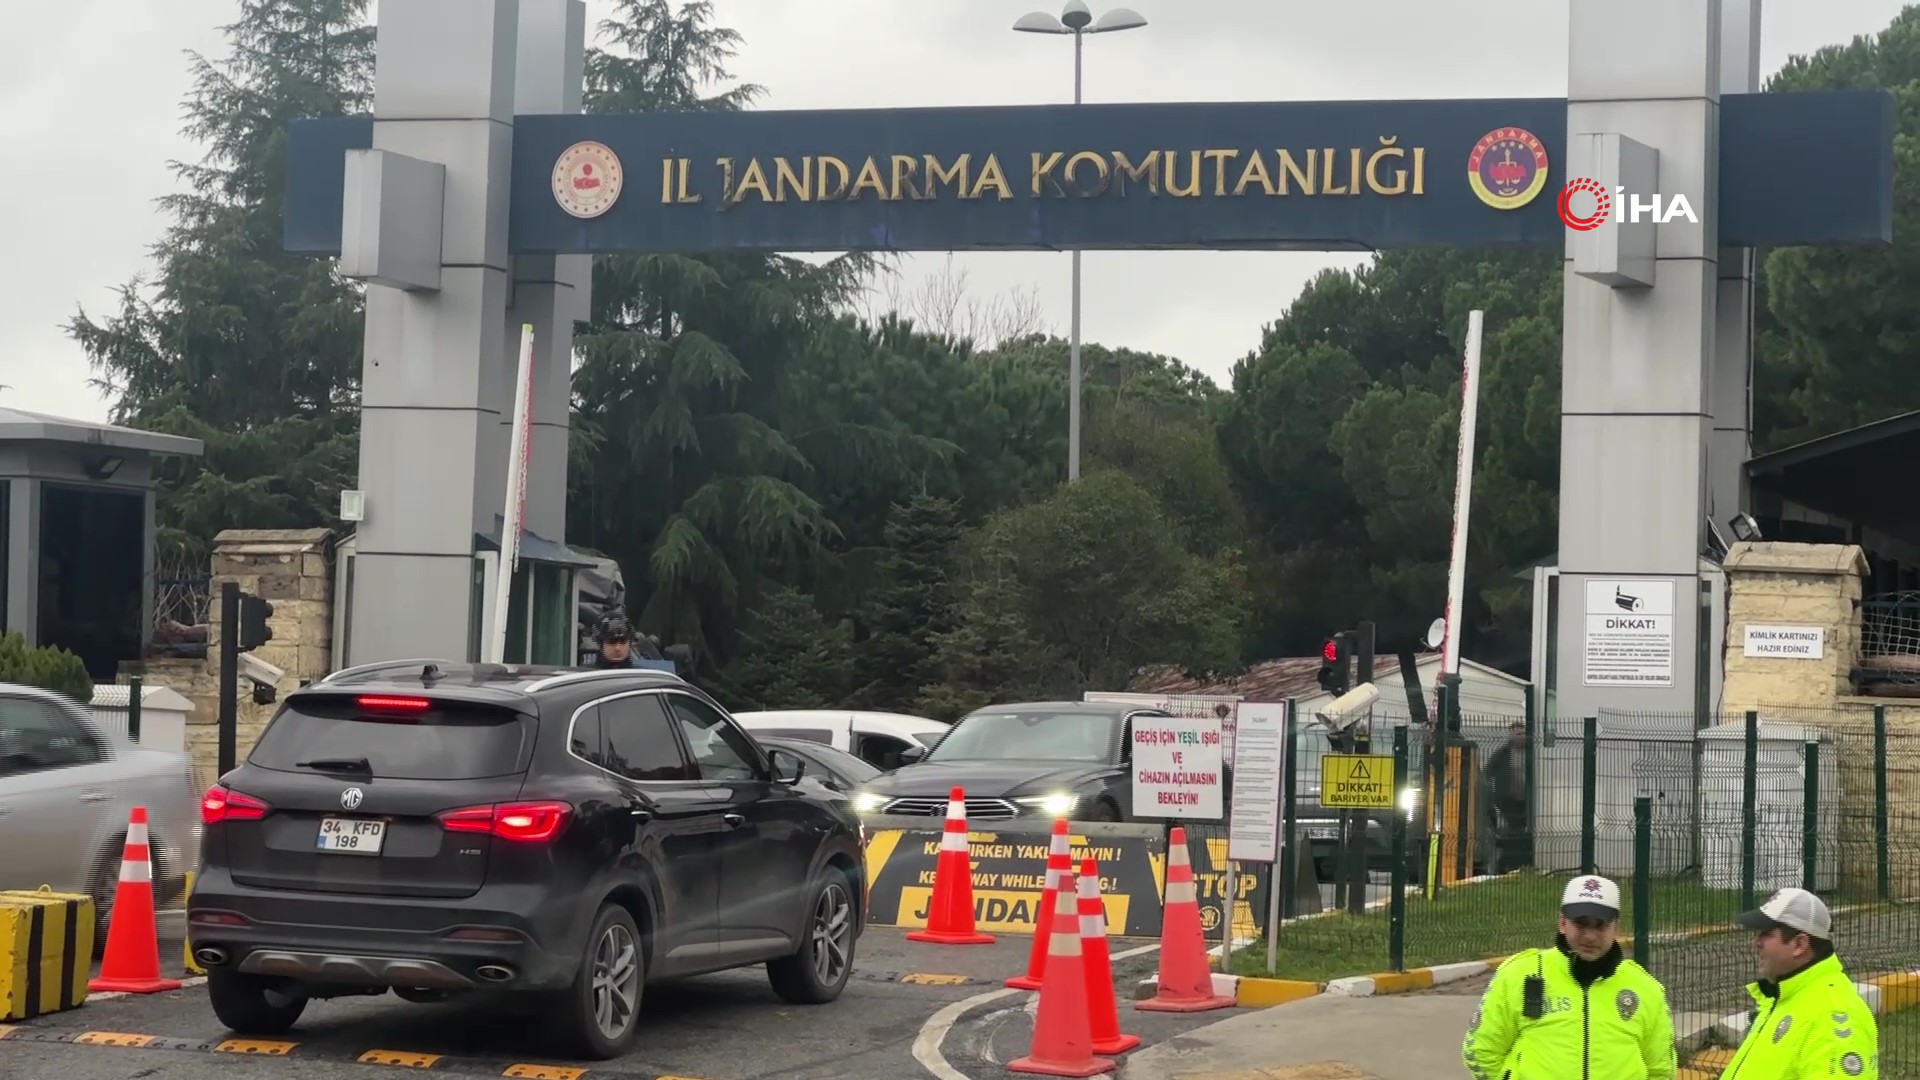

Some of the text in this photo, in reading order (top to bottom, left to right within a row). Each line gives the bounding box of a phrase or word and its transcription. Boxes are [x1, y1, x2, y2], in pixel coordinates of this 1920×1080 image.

[715, 151, 1015, 213] JANDARMA
[1030, 134, 1426, 199] KOMUTANLIĞI
[1605, 616, 1657, 629] DİKKAT!
[1749, 630, 1818, 641] KİMLİK KARTINIZI
[1757, 644, 1810, 654] HAZIR EDİNİZ
[1135, 728, 1220, 748] GEÇİŞ İÇİN YEŞİL IŞIĞI
[1172, 751, 1183, 764] VE
[1139, 768, 1217, 788] CİHAZIN AÇILMASINI
[1157, 790, 1199, 805] BEKLEYİN!
[1370, 794, 1389, 803] VAR
[323, 821, 381, 836] 34 KFD
[335, 835, 359, 848] 198
[1016, 845, 1114, 861] YAKLMAYIN
[1001, 874, 1046, 889] WHILE
